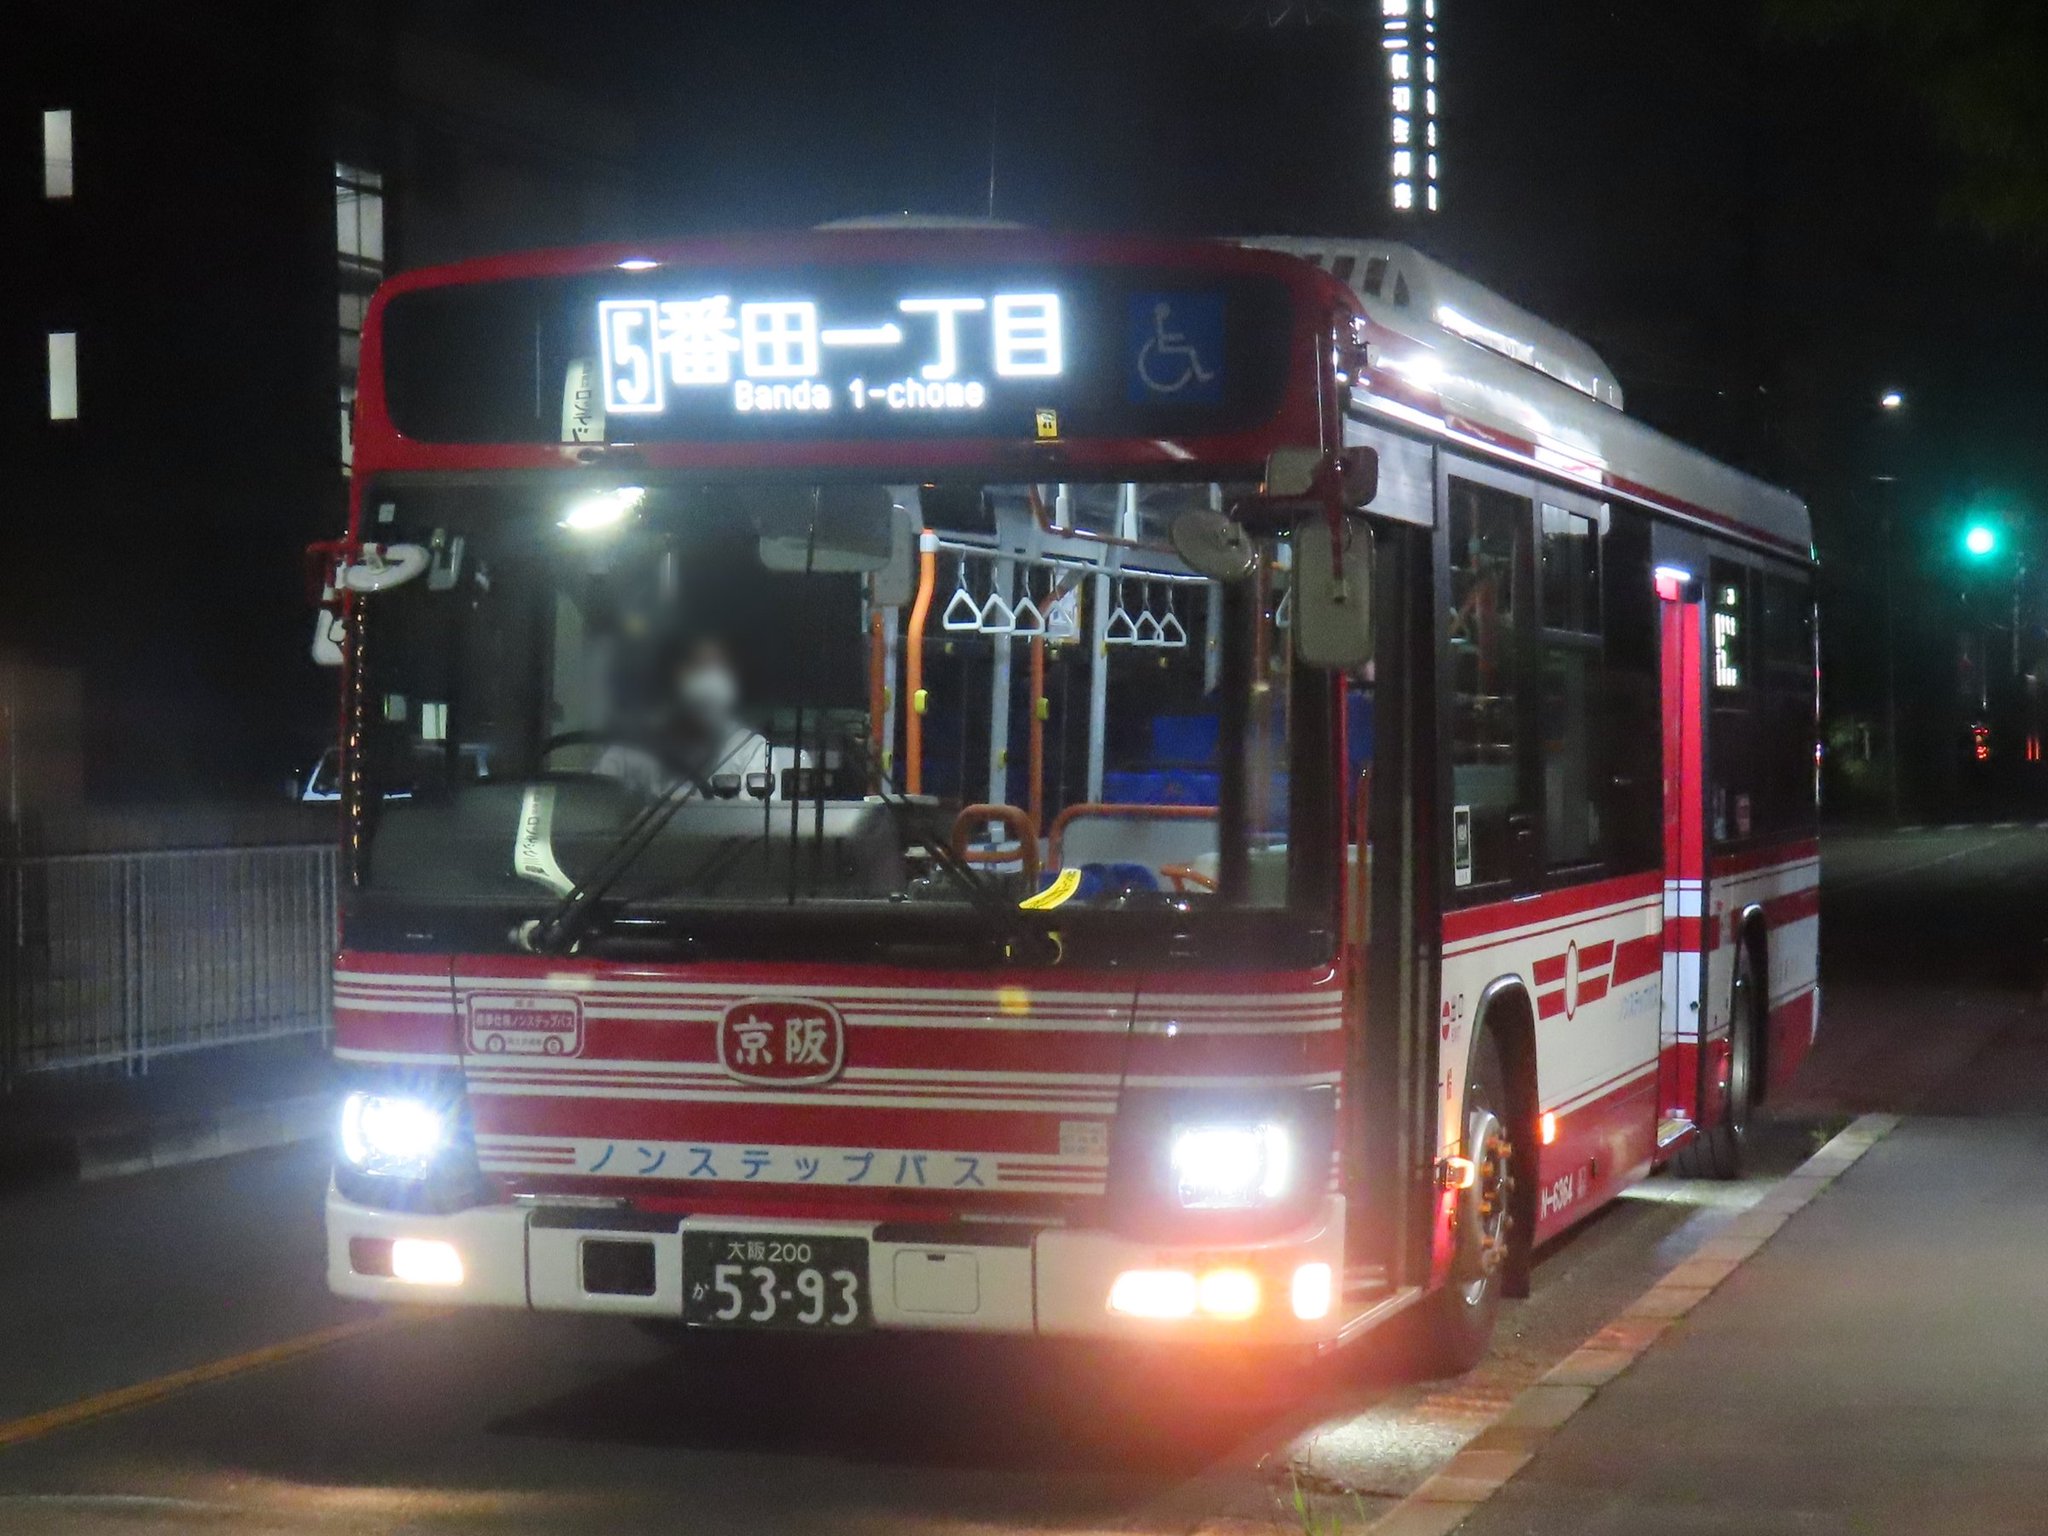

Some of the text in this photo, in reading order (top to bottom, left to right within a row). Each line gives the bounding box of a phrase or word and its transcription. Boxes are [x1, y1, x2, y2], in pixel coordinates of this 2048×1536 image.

[612, 310, 650, 403] 5
[659, 294, 1062, 384] 番田一丁目
[735, 378, 986, 411] Banda 1-chome
[733, 1014, 830, 1065] 京阪
[590, 1144, 984, 1187] ノンステップバス
[715, 1264, 858, 1326] 53-93
